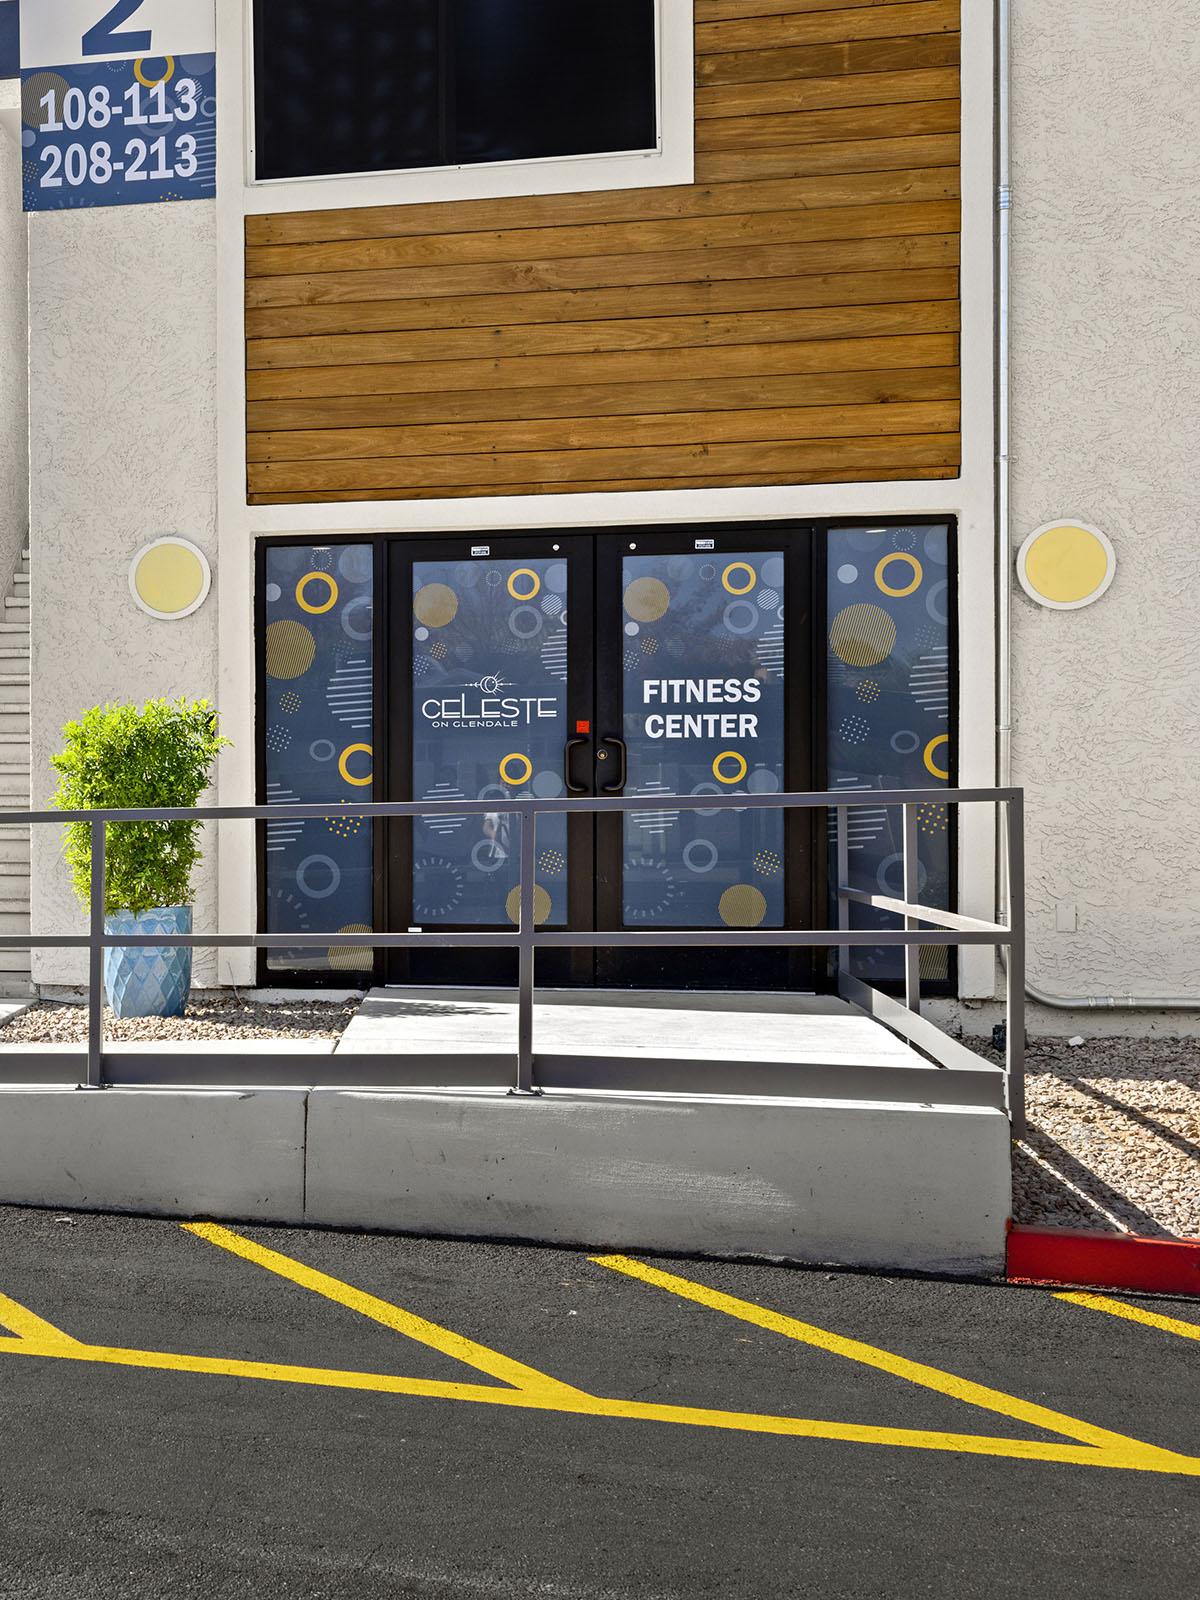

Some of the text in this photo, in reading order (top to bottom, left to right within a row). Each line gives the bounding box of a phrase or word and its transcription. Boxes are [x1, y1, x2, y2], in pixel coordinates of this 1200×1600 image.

[39, 78, 197, 132] 108-113
[40, 134, 198, 188] 208-213
[643, 678, 761, 704] FITNESS
[422, 693, 557, 724] CELESTE
[453, 720, 518, 728] GLENDALE
[645, 714, 758, 738] CENTER
